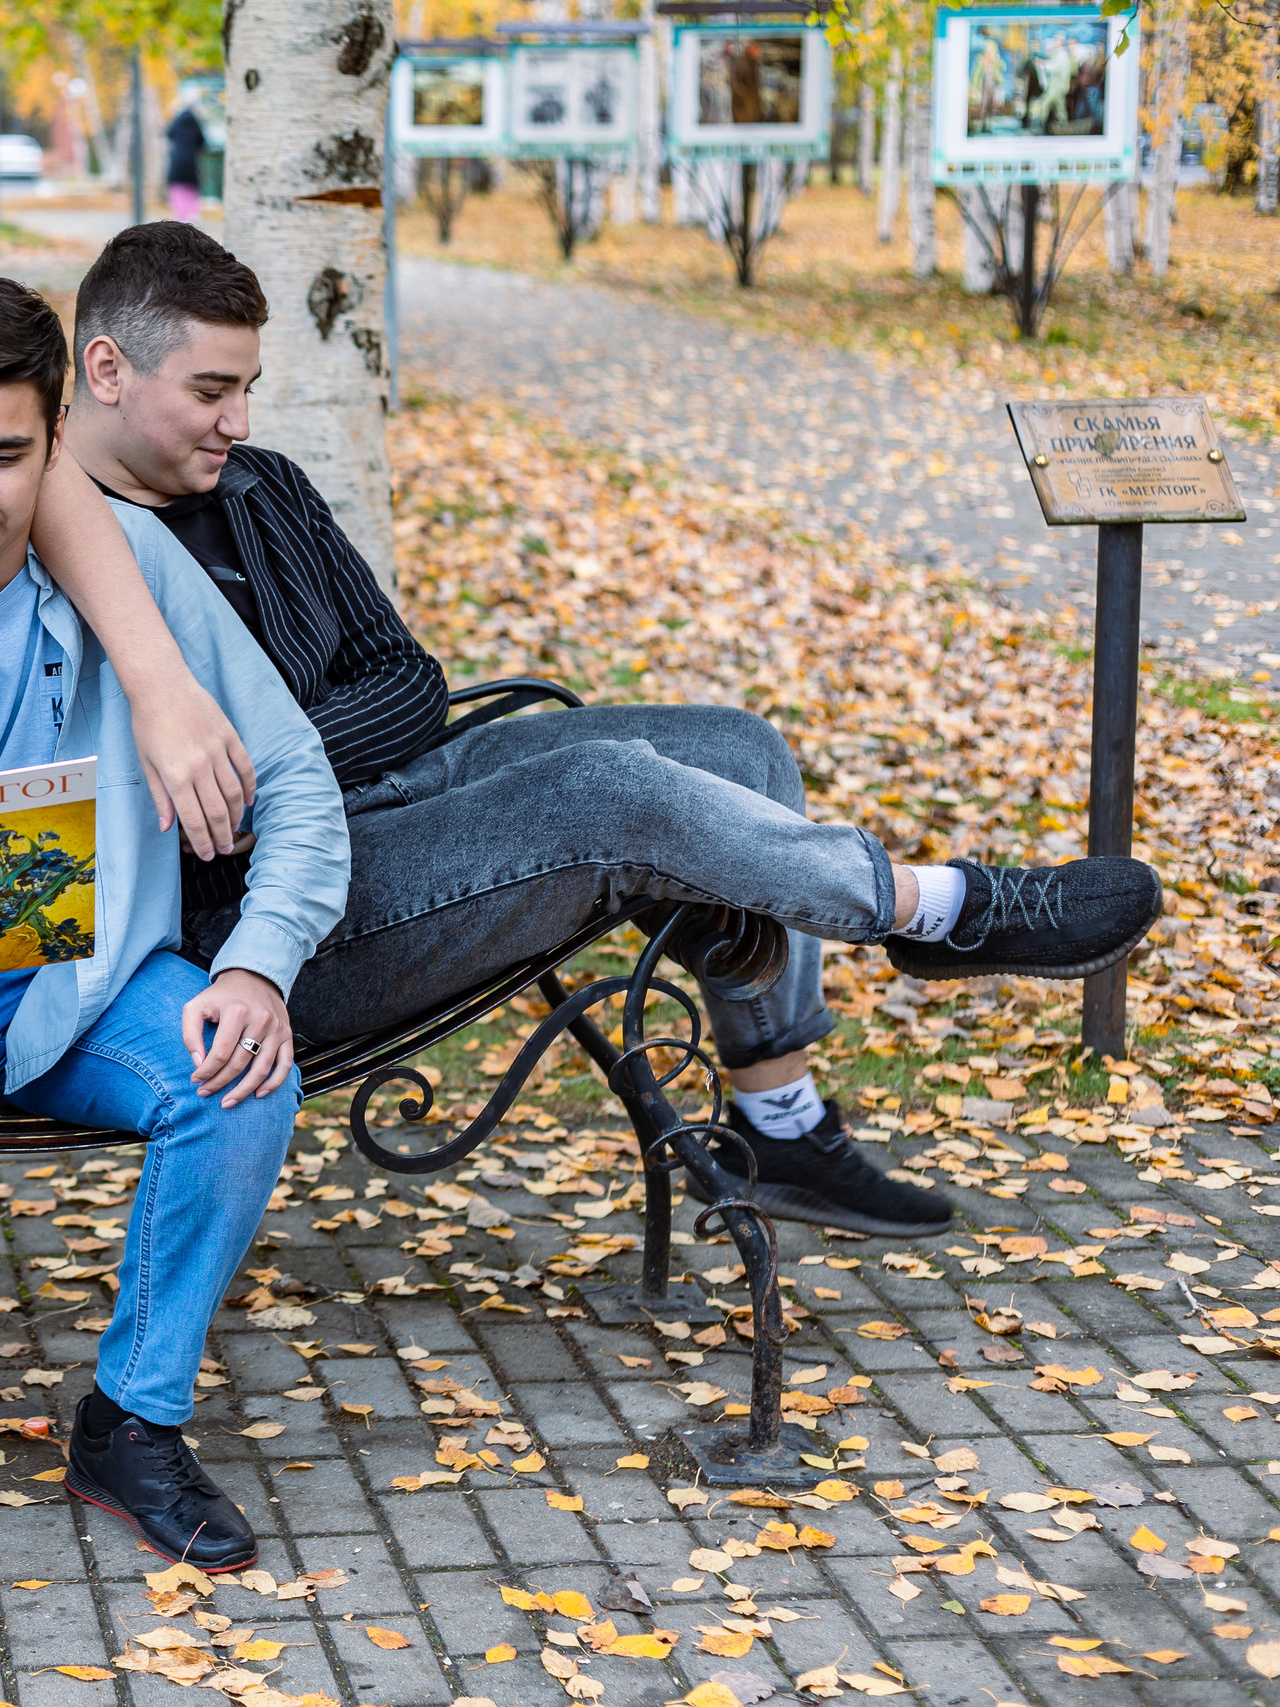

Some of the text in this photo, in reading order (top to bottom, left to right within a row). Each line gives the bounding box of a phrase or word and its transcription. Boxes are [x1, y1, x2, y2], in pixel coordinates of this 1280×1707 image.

[1074, 416, 1161, 432] СКАМЬЯ
[1050, 435, 1198, 452] ПРИИРЕНИЯ
[1099, 486, 1117, 497] ГК
